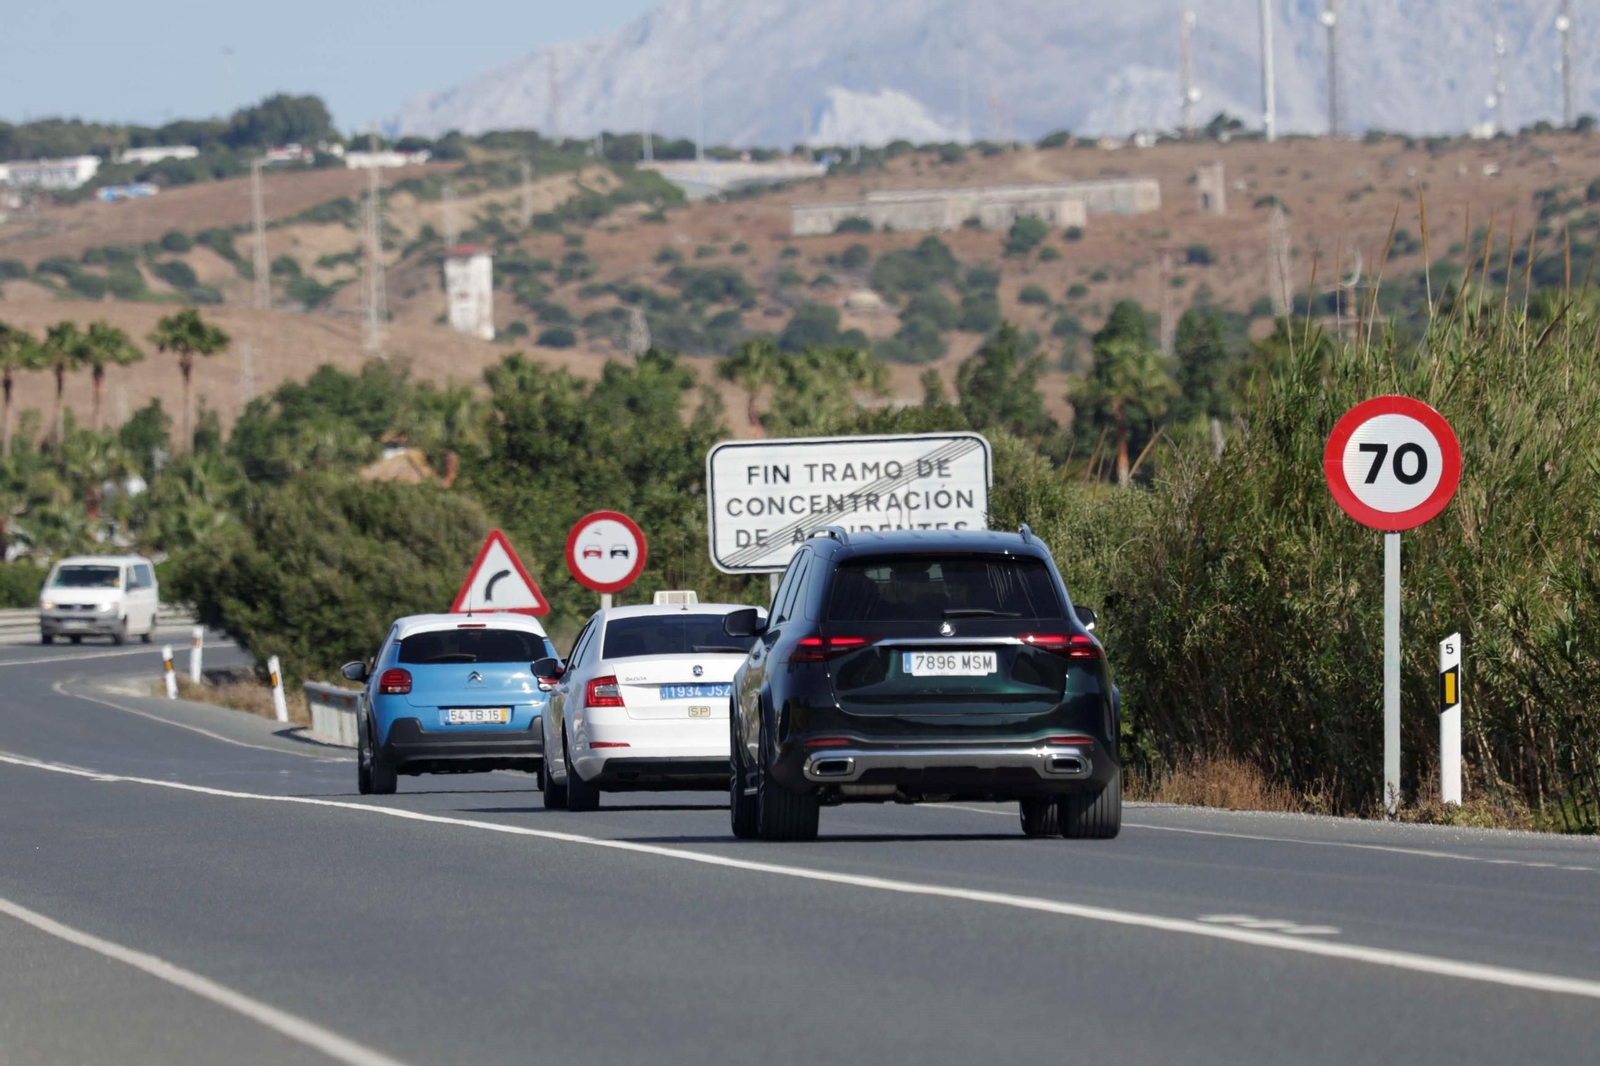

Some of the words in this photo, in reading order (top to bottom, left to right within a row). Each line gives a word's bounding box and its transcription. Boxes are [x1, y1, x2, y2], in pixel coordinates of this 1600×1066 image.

[747, 465, 790, 485] FIN
[804, 461, 903, 483] TRAMO
[917, 458, 952, 478] DE
[1358, 442, 1428, 485] 70
[726, 484, 974, 517] CONCENTRACIÓN
[735, 528, 770, 548] DE
[1445, 643, 1454, 655] 5
[916, 655, 956, 670] 7896
[961, 655, 992, 670] MSM
[670, 685, 702, 698] 1934
[690, 707, 709, 716] SP
